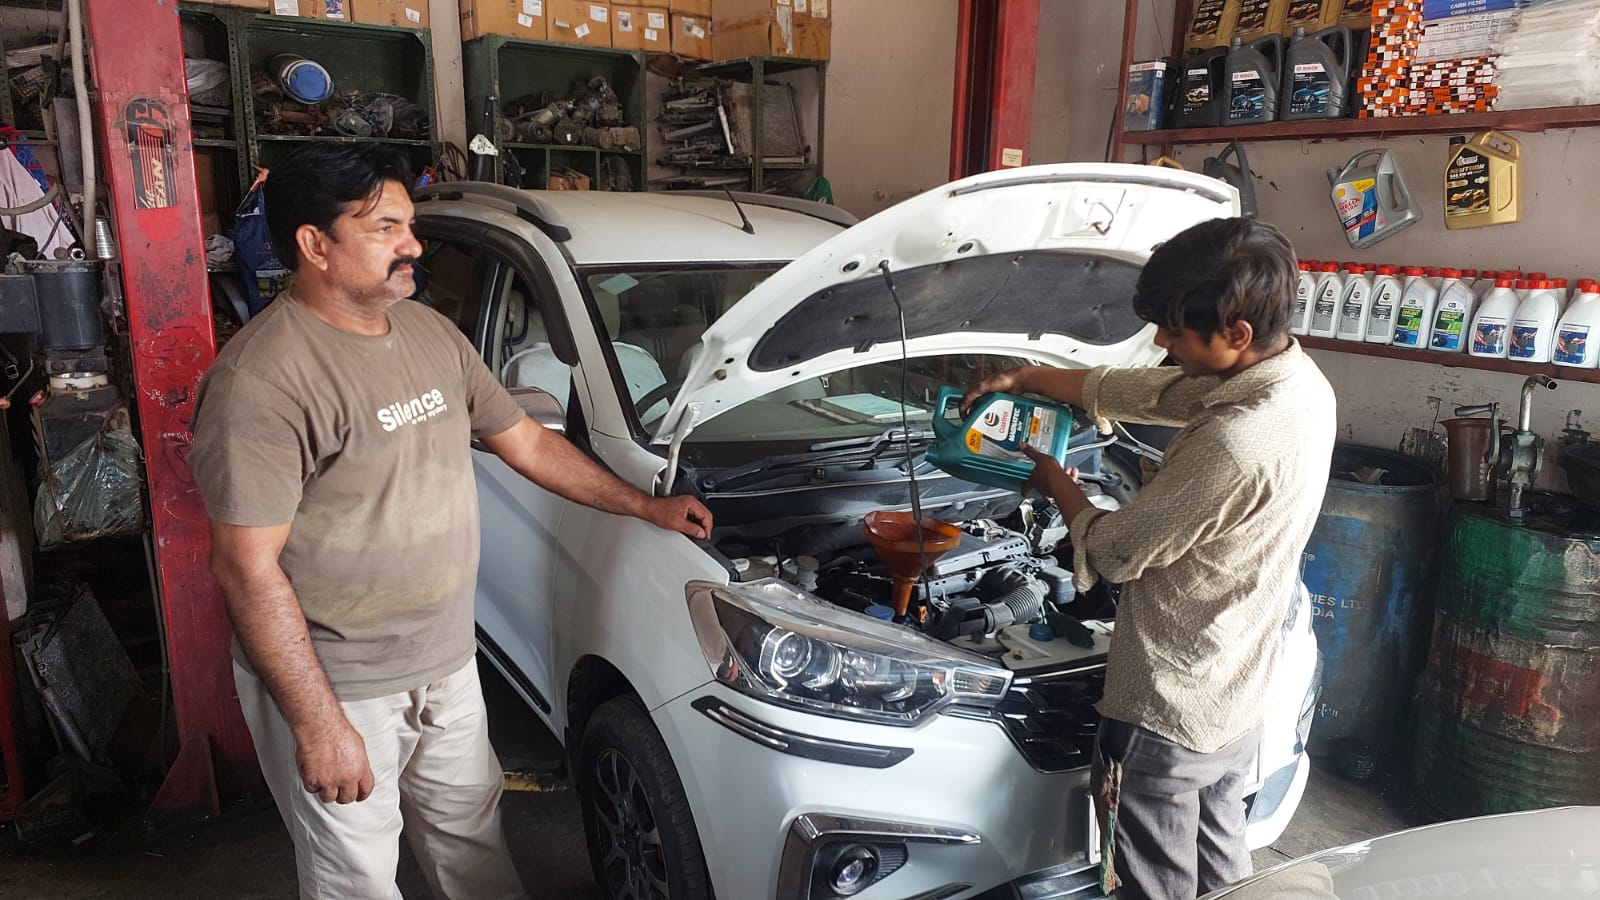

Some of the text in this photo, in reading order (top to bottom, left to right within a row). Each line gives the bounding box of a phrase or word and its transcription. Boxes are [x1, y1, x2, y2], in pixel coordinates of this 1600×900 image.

[377, 388, 444, 432] Silence
[999, 411, 1008, 434] Castrol
[1008, 407, 1021, 442] MAGNATEC
